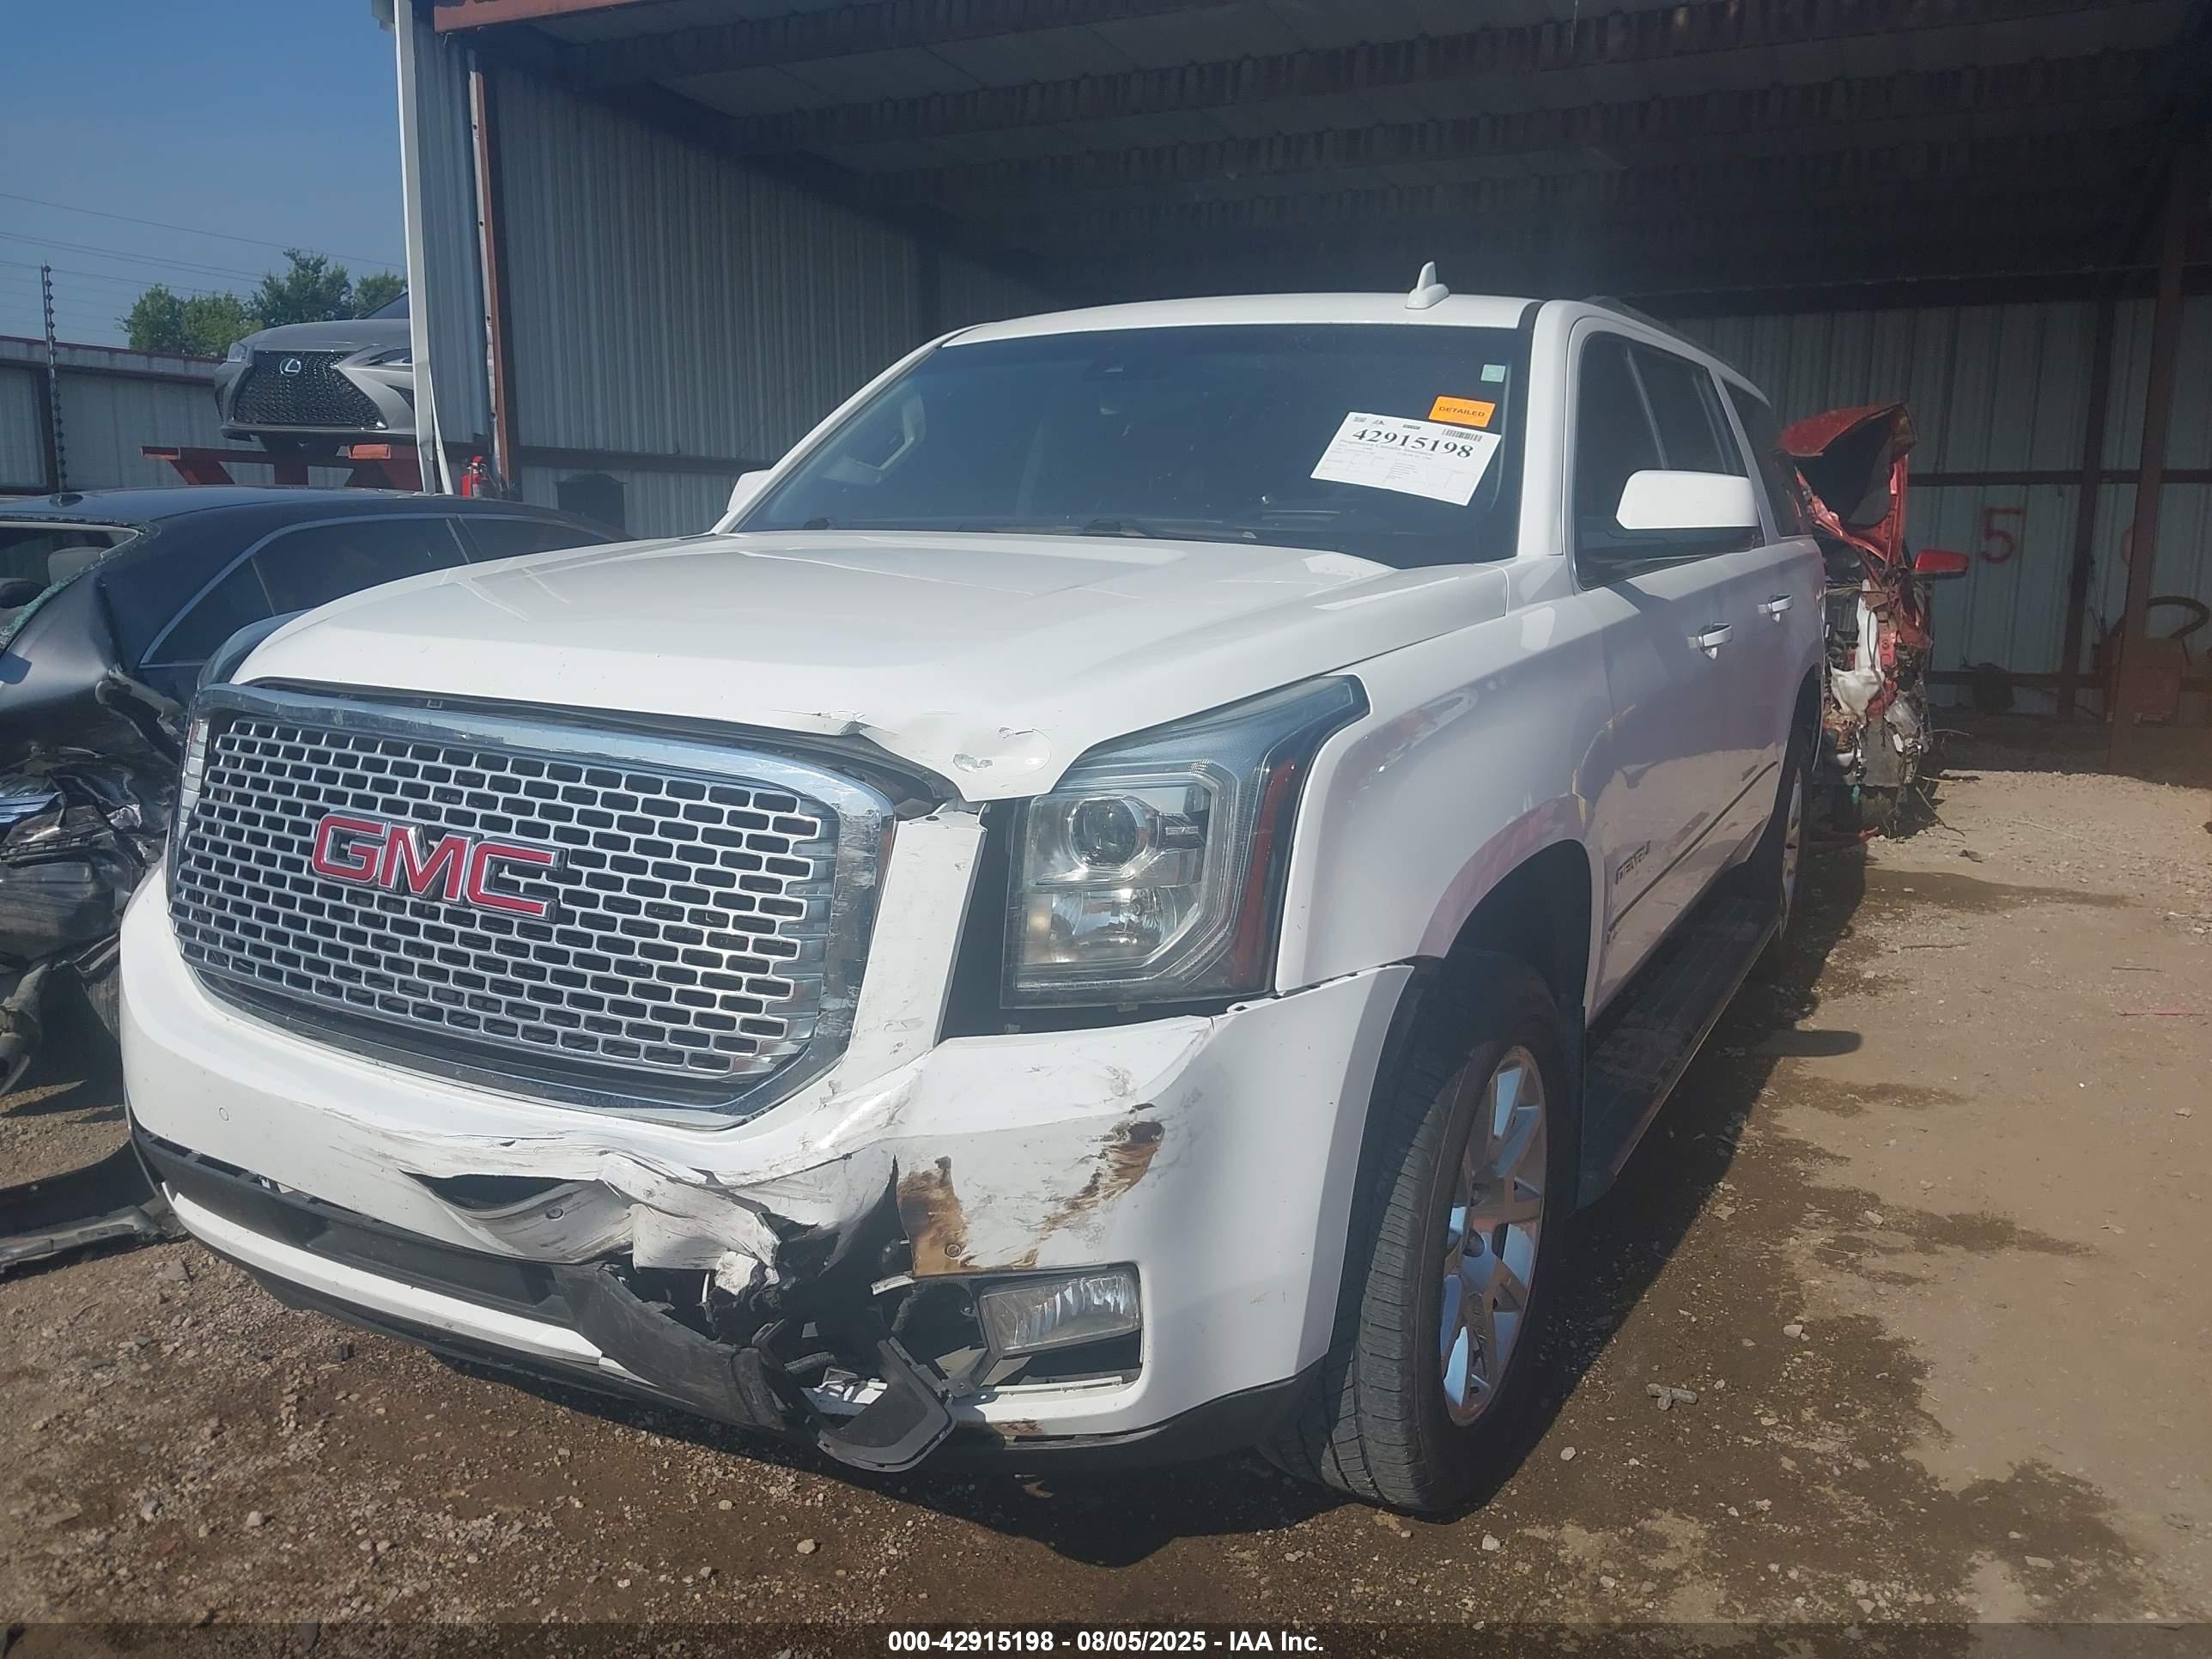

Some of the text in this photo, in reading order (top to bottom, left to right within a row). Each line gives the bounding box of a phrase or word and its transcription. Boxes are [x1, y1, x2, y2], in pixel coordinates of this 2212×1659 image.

[1438, 405, 1486, 417] DETAILED
[1352, 428, 1474, 459] 42915198
[1979, 507, 2027, 565] 5
[312, 812, 564, 920] GMC
